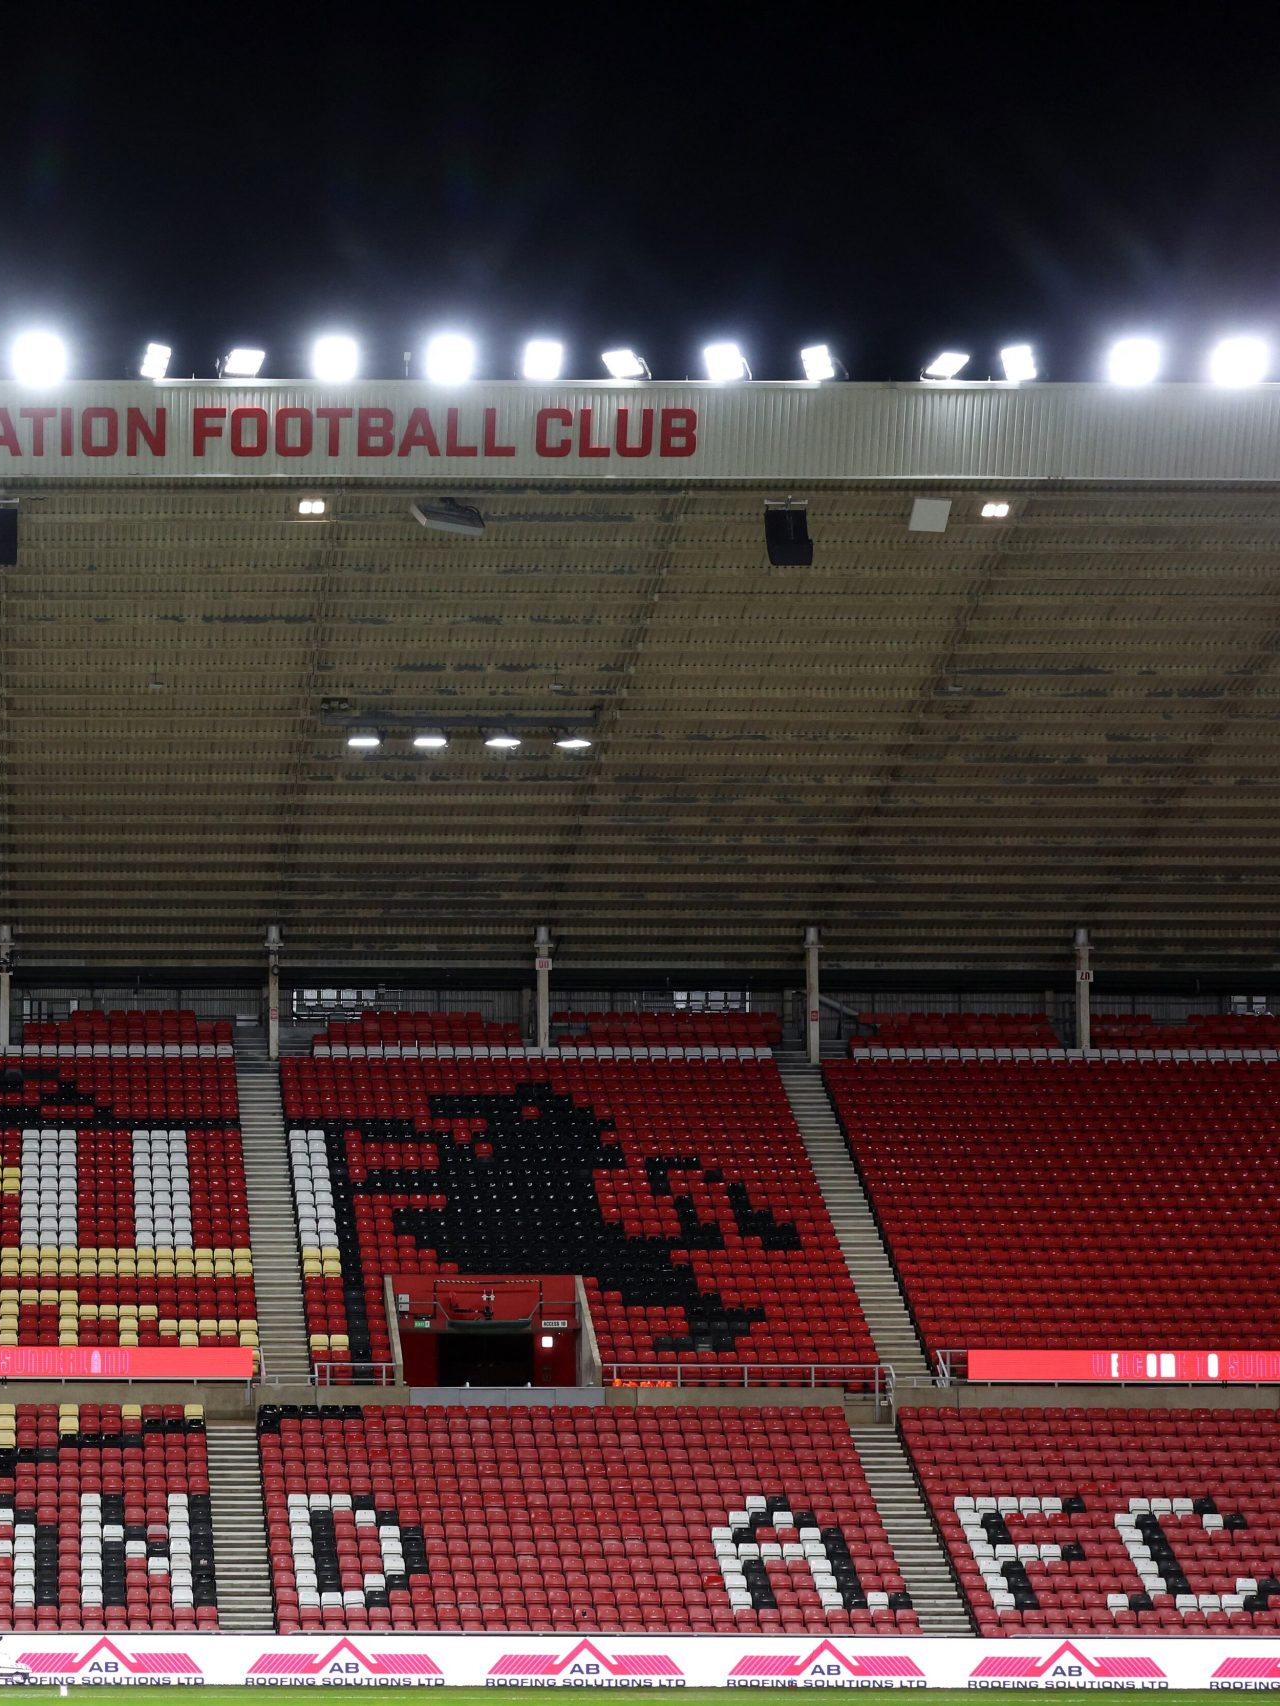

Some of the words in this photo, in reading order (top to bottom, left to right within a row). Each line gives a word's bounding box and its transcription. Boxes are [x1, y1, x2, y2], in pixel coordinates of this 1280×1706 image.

[192, 407, 516, 457] FOOTBALL
[535, 408, 697, 458] CLUB
[0, 1348, 130, 1374] SUNDERLAND
[88, 1662, 118, 1672] AB
[328, 1663, 359, 1673] AB
[570, 1664, 600, 1674] AB
[810, 1665, 841, 1675] AB
[1052, 1666, 1082, 1676] AB
[81, 1677, 170, 1685] SOLUTIONS
[177, 1677, 204, 1685] LTD
[246, 1678, 316, 1686] ROOFING
[322, 1678, 411, 1686] SOLUTIONS
[418, 1678, 445, 1686] LTD
[486, 1679, 556, 1687] ROOFING
[562, 1679, 651, 1687] SOLUTIONS
[658, 1679, 685, 1687] LTD
[727, 1680, 797, 1688] ROOFING
[803, 1680, 892, 1688] SOLUTIONS
[899, 1680, 926, 1688] LTD
[968, 1681, 1038, 1689] ROOFING
[1044, 1681, 1133, 1689] SOLUTIONS
[1140, 1681, 1167, 1689] LTD
